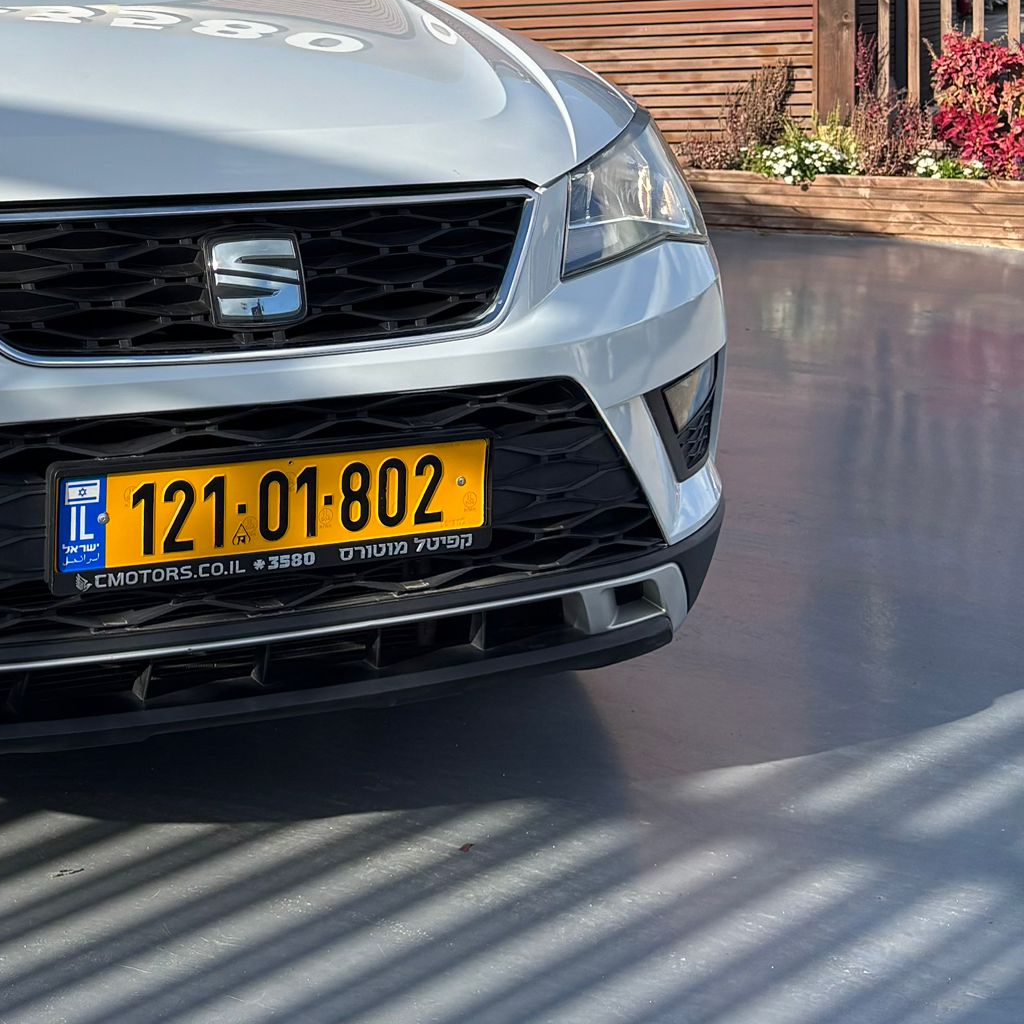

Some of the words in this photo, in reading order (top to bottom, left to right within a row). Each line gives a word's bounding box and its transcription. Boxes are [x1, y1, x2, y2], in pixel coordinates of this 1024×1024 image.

[70, 505, 94, 542] IL
[61, 543, 100, 554] ישראל
[338, 540, 408, 562] מוטורס
[413, 533, 473, 553] קפיטל
[94, 561, 246, 589] CMOTORS.CO.IL
